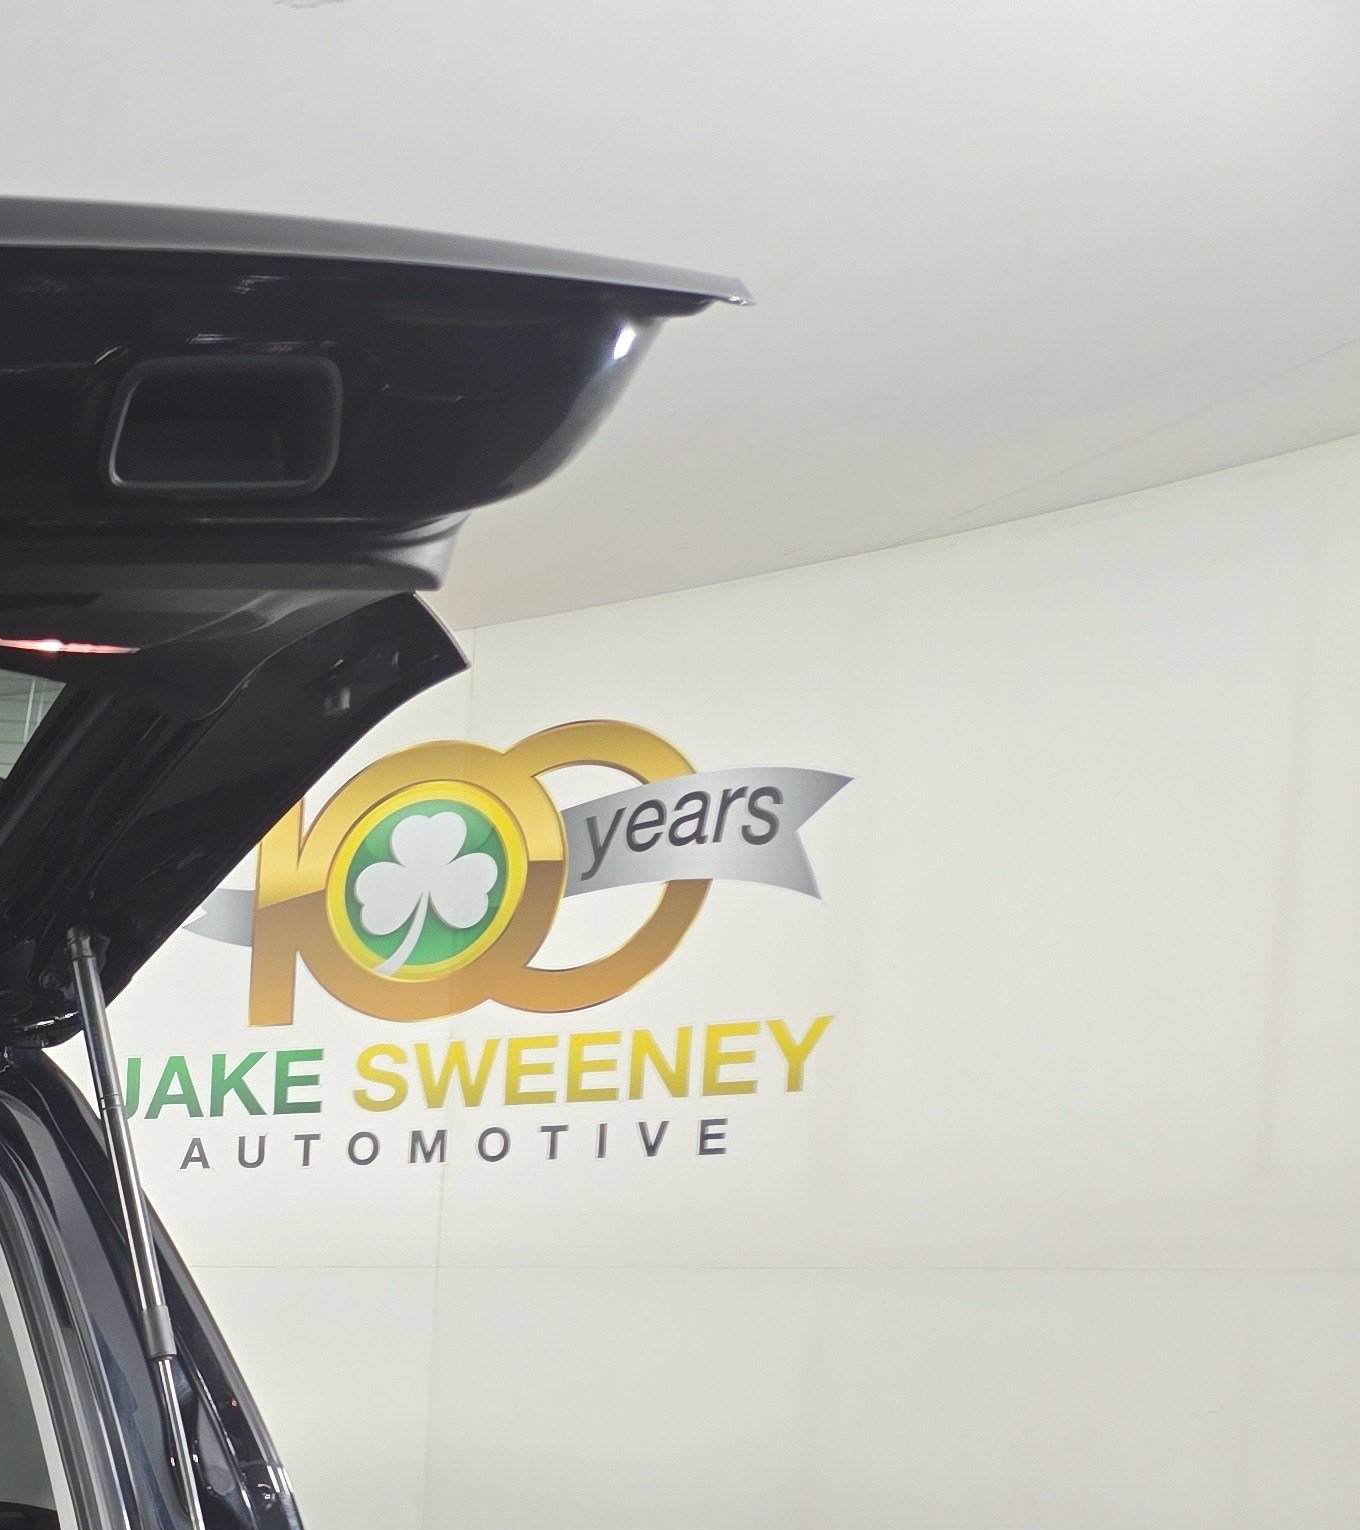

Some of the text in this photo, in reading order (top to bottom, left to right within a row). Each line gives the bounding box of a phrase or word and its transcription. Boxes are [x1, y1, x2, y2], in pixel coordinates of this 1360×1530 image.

[579, 786, 785, 882] years
[353, 1013, 835, 1114] SWEENEY
[179, 1117, 729, 1172] AUTOMOTIVE
